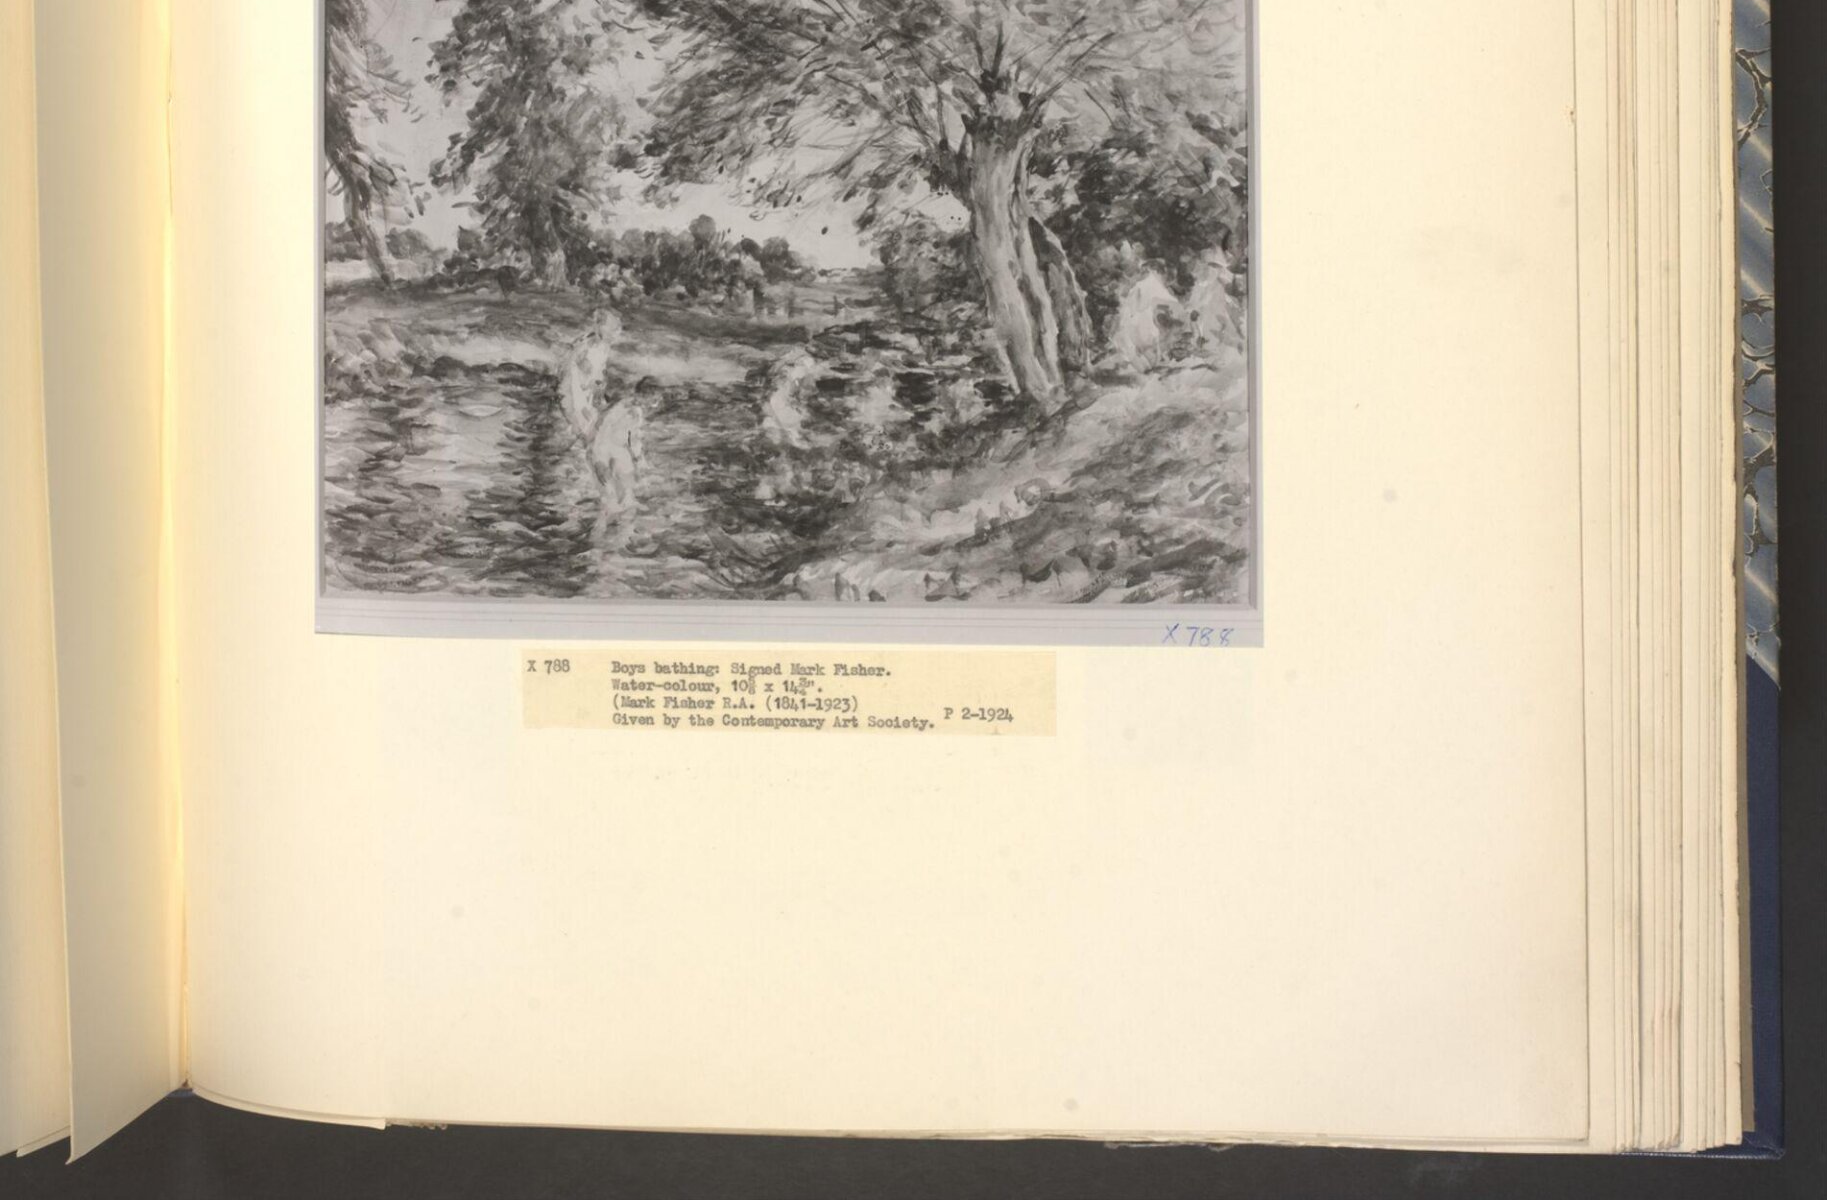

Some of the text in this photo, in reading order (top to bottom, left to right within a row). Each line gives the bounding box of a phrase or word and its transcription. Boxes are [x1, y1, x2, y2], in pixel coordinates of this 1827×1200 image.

[527, 659, 570, 675] X 788
[611, 661, 646, 676] Boys
[731, 663, 782, 677] Signed
[790, 663, 826, 676] Mark
[833, 664, 891, 677] Fisher.
[611, 679, 721, 694] Water-colour,
[764, 683, 774, 692] x
[613, 693, 858, 712] (Mark Fisher R.A. (1841-1923)
[612, 712, 935, 732] Given by the Contemporary Art Society.
[944, 707, 1014, 722] P 2-1924
